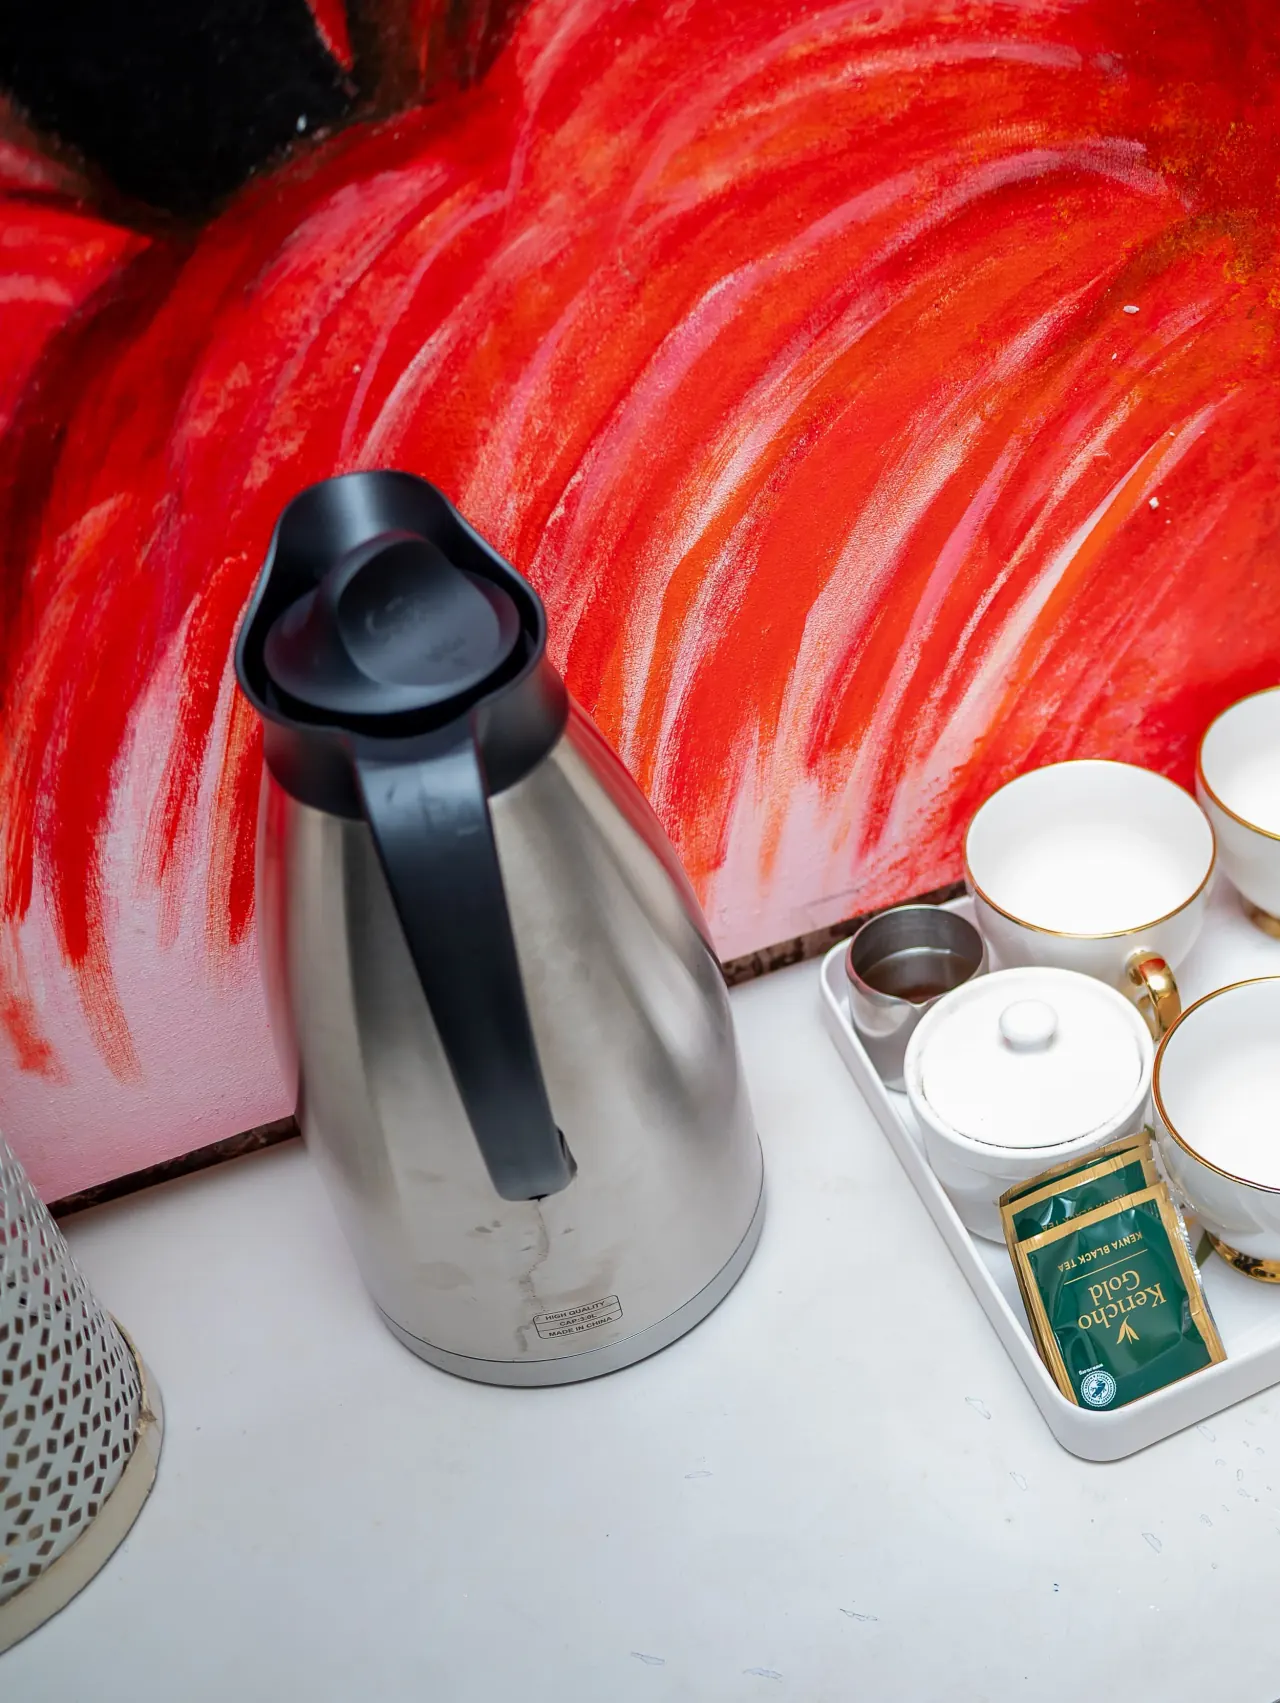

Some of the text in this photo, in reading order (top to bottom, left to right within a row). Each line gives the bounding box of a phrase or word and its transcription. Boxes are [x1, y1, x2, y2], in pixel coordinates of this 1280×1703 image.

[1057, 1231, 1143, 1272] KENYA BLACK TEA
[1077, 1283, 1167, 1330] Kericho
[1088, 1270, 1140, 1307] Gold
[545, 1301, 605, 1321] HIGH QUALITY
[548, 1327, 574, 1337] MADE
[586, 1316, 613, 1328] CHINA
